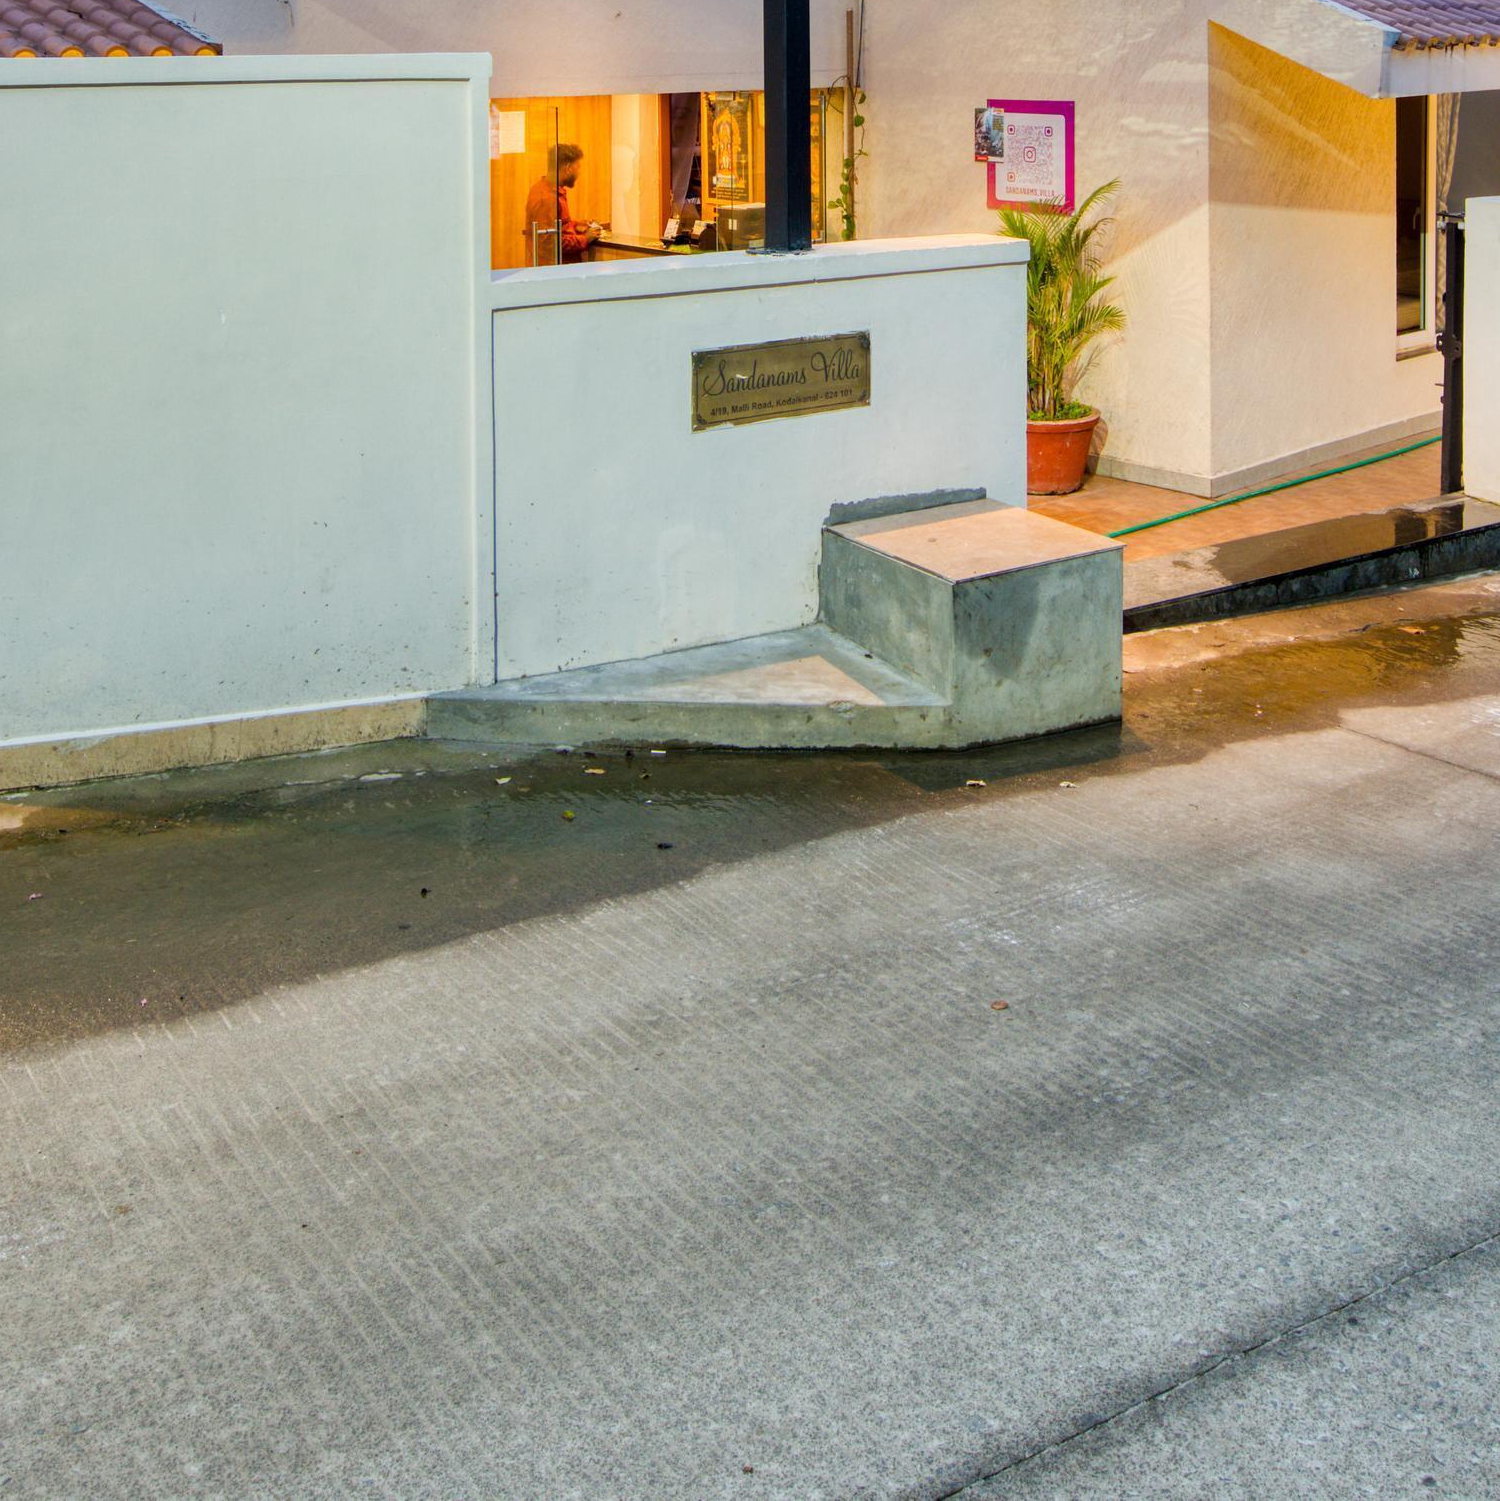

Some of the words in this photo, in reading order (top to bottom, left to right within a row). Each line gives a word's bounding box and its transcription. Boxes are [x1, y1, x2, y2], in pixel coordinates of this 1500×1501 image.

[701, 359, 807, 398] Sandanams
[810, 346, 861, 383] Villa
[752, 401, 774, 410] Road,
